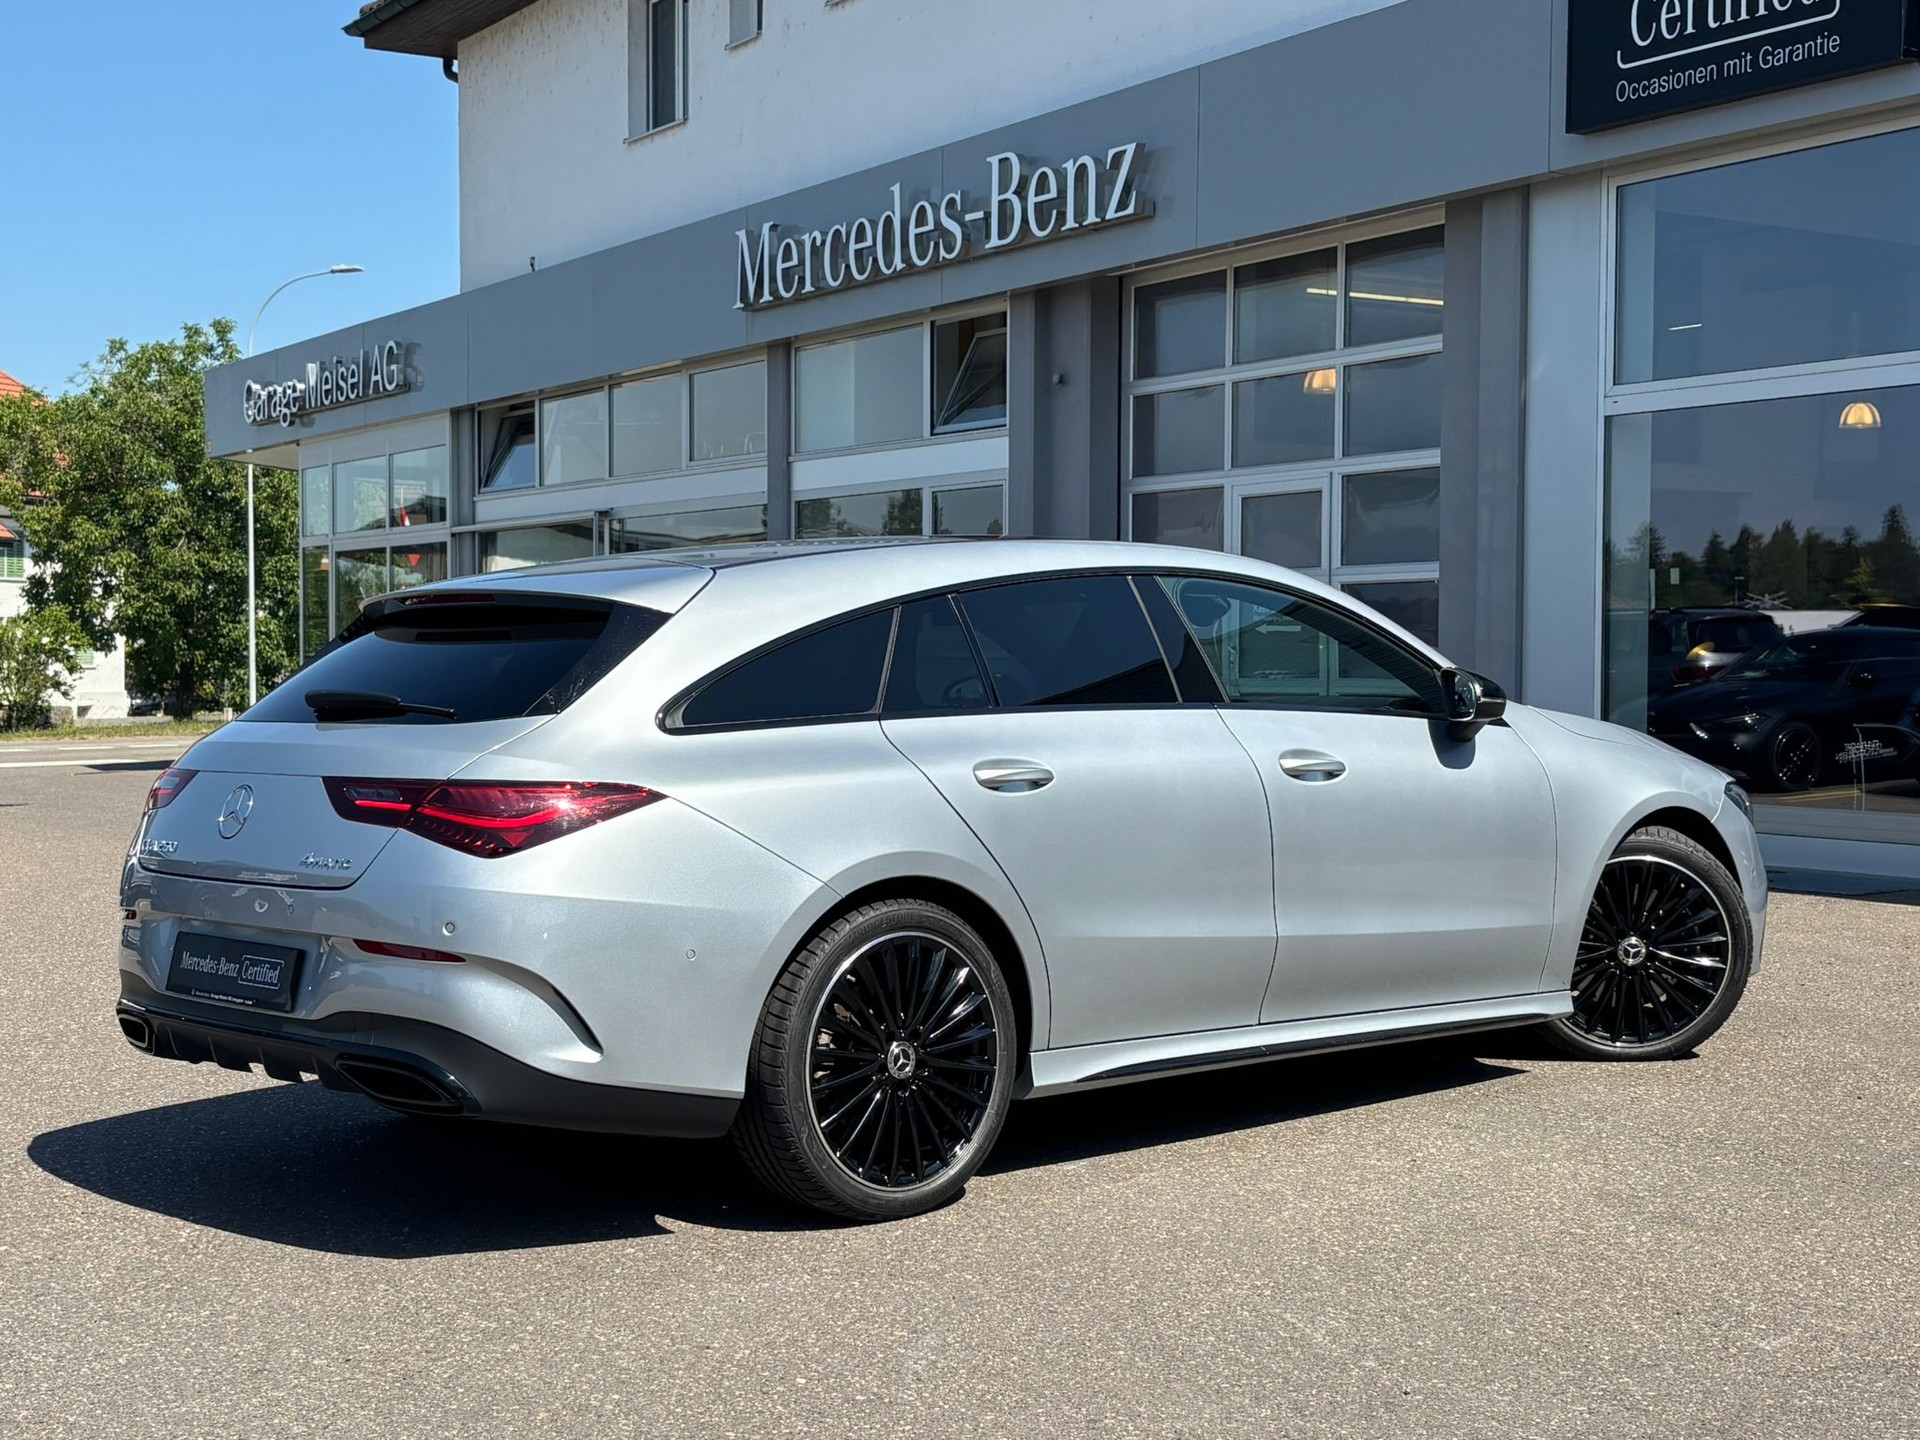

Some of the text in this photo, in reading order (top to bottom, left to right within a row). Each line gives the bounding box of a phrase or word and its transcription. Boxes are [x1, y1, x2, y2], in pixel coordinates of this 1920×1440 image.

[1630, 0, 1818, 47] Certi
[1616, 31, 1841, 103] Occasionen mit Garantie
[732, 141, 1140, 310] Mercedes-Benz
[243, 339, 399, 428] Garage Meisel AG
[179, 950, 281, 984] Mercedes-Benz Certified
